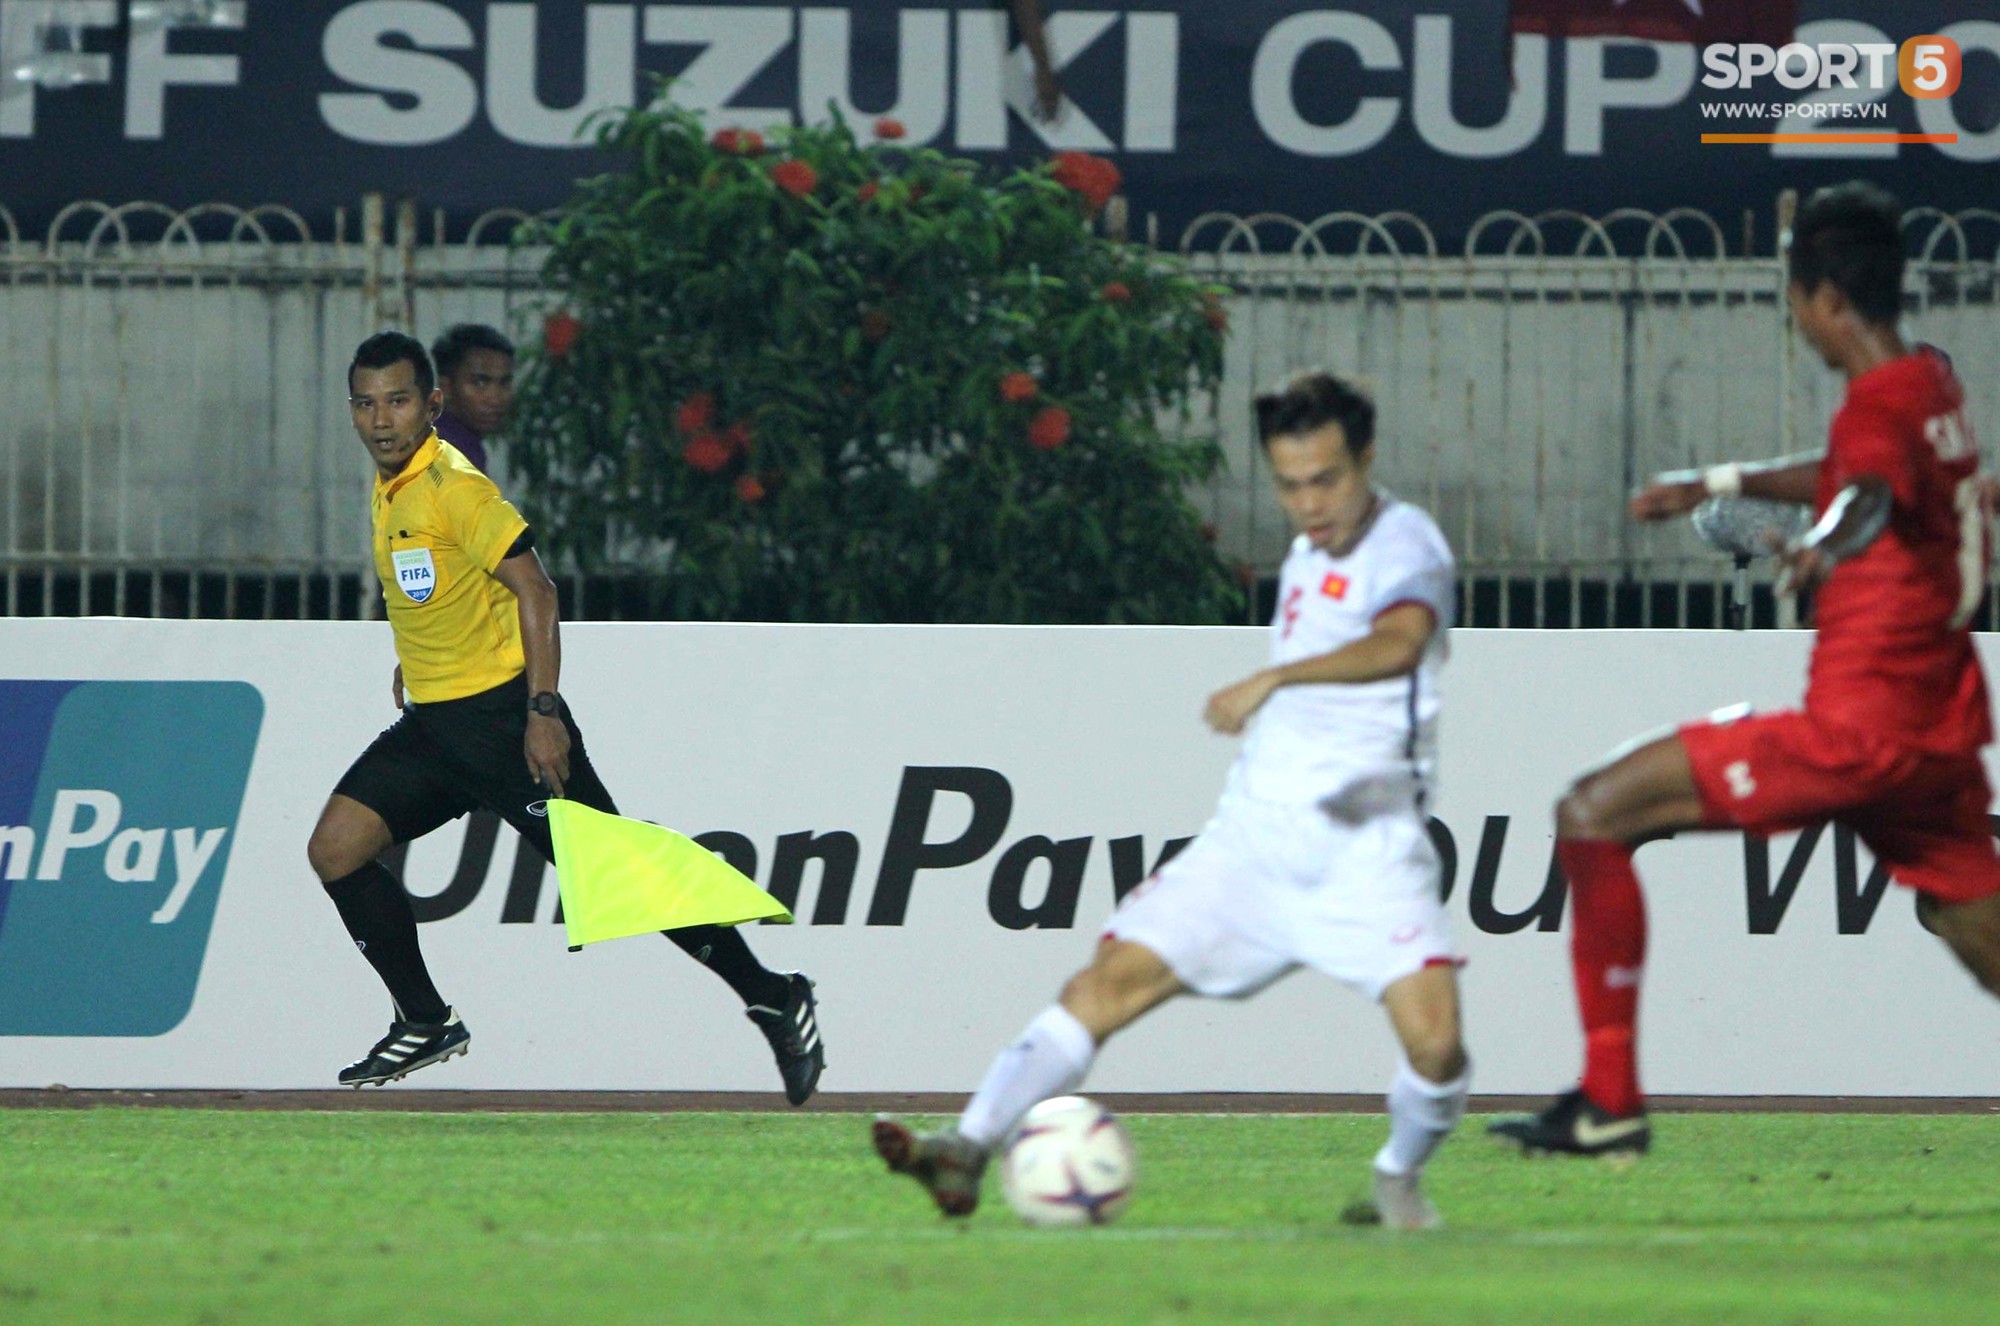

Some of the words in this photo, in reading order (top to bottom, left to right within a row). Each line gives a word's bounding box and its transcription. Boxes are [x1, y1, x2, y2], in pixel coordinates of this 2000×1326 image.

[318, 0, 1179, 150] SUZUKI
[1250, 10, 1699, 158] CUP
[401, 567, 431, 582] FIFA
